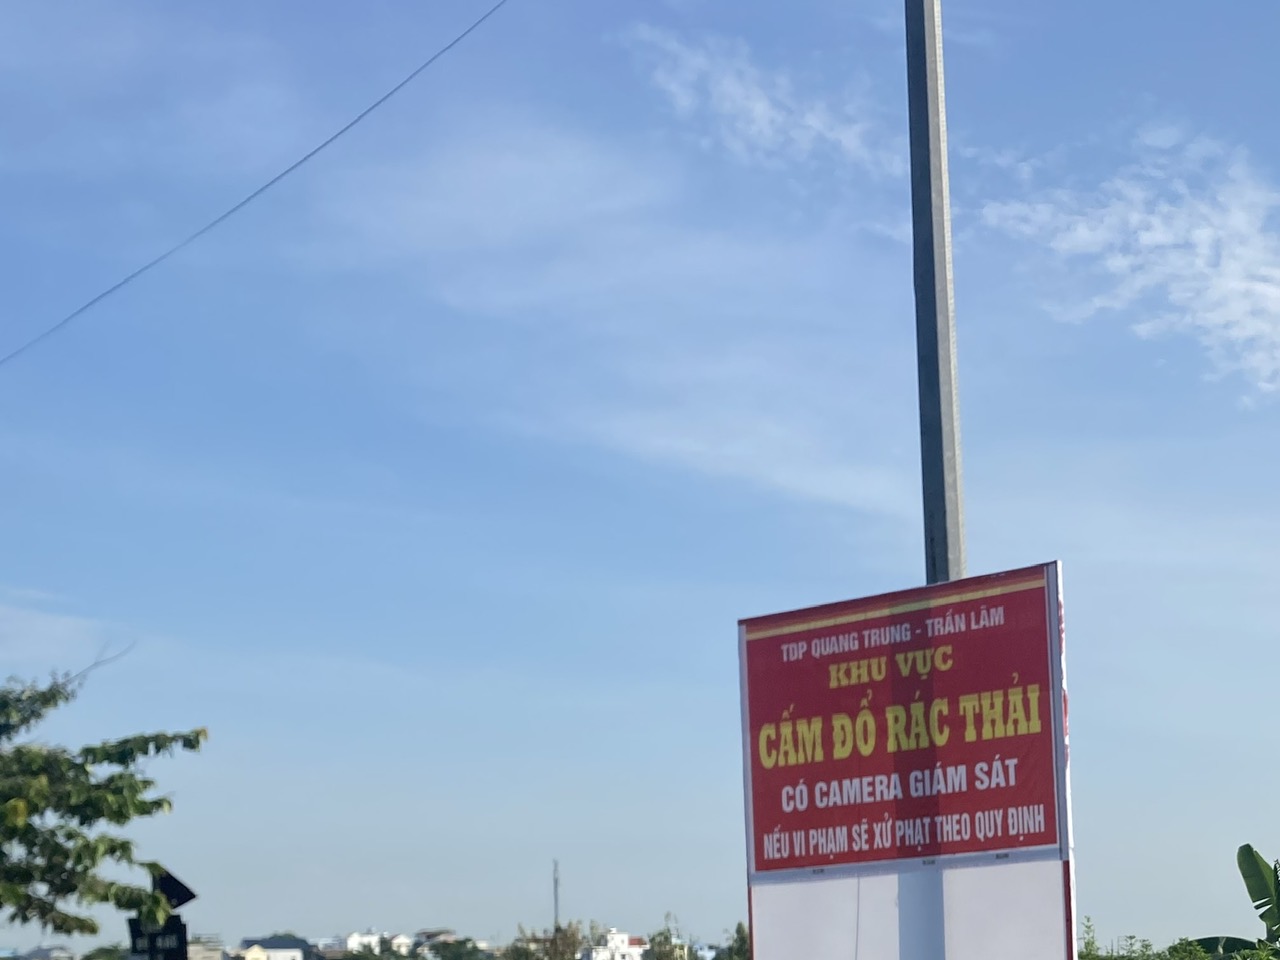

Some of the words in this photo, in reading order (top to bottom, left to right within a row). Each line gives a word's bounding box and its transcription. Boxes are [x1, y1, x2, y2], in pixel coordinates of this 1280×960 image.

[811, 631, 859, 659] QUANG
[863, 623, 911, 648] TRUNG
[829, 656, 887, 689] KHU
[895, 645, 953, 680] VỰC
[759, 704, 824, 769] CẤM
[832, 689, 877, 760] ĐỔ
[885, 690, 950, 753] RÁC
[959, 673, 1041, 743] THẢI
[781, 779, 808, 813] CÓ
[815, 773, 903, 807] CAMERA
[909, 761, 967, 798] GIÁM
[975, 755, 1018, 790] SÁT
[764, 824, 789, 860] NẾU
[793, 833, 805, 857] VI
[809, 825, 848, 860] PHẠM
[852, 817, 869, 852] SẼ
[873, 812, 892, 849] XỬ
[895, 816, 930, 851] PHẠT
[934, 812, 970, 842] THEO
[975, 809, 1003, 841] QUY
[1007, 804, 1045, 841] ĐỊNH
